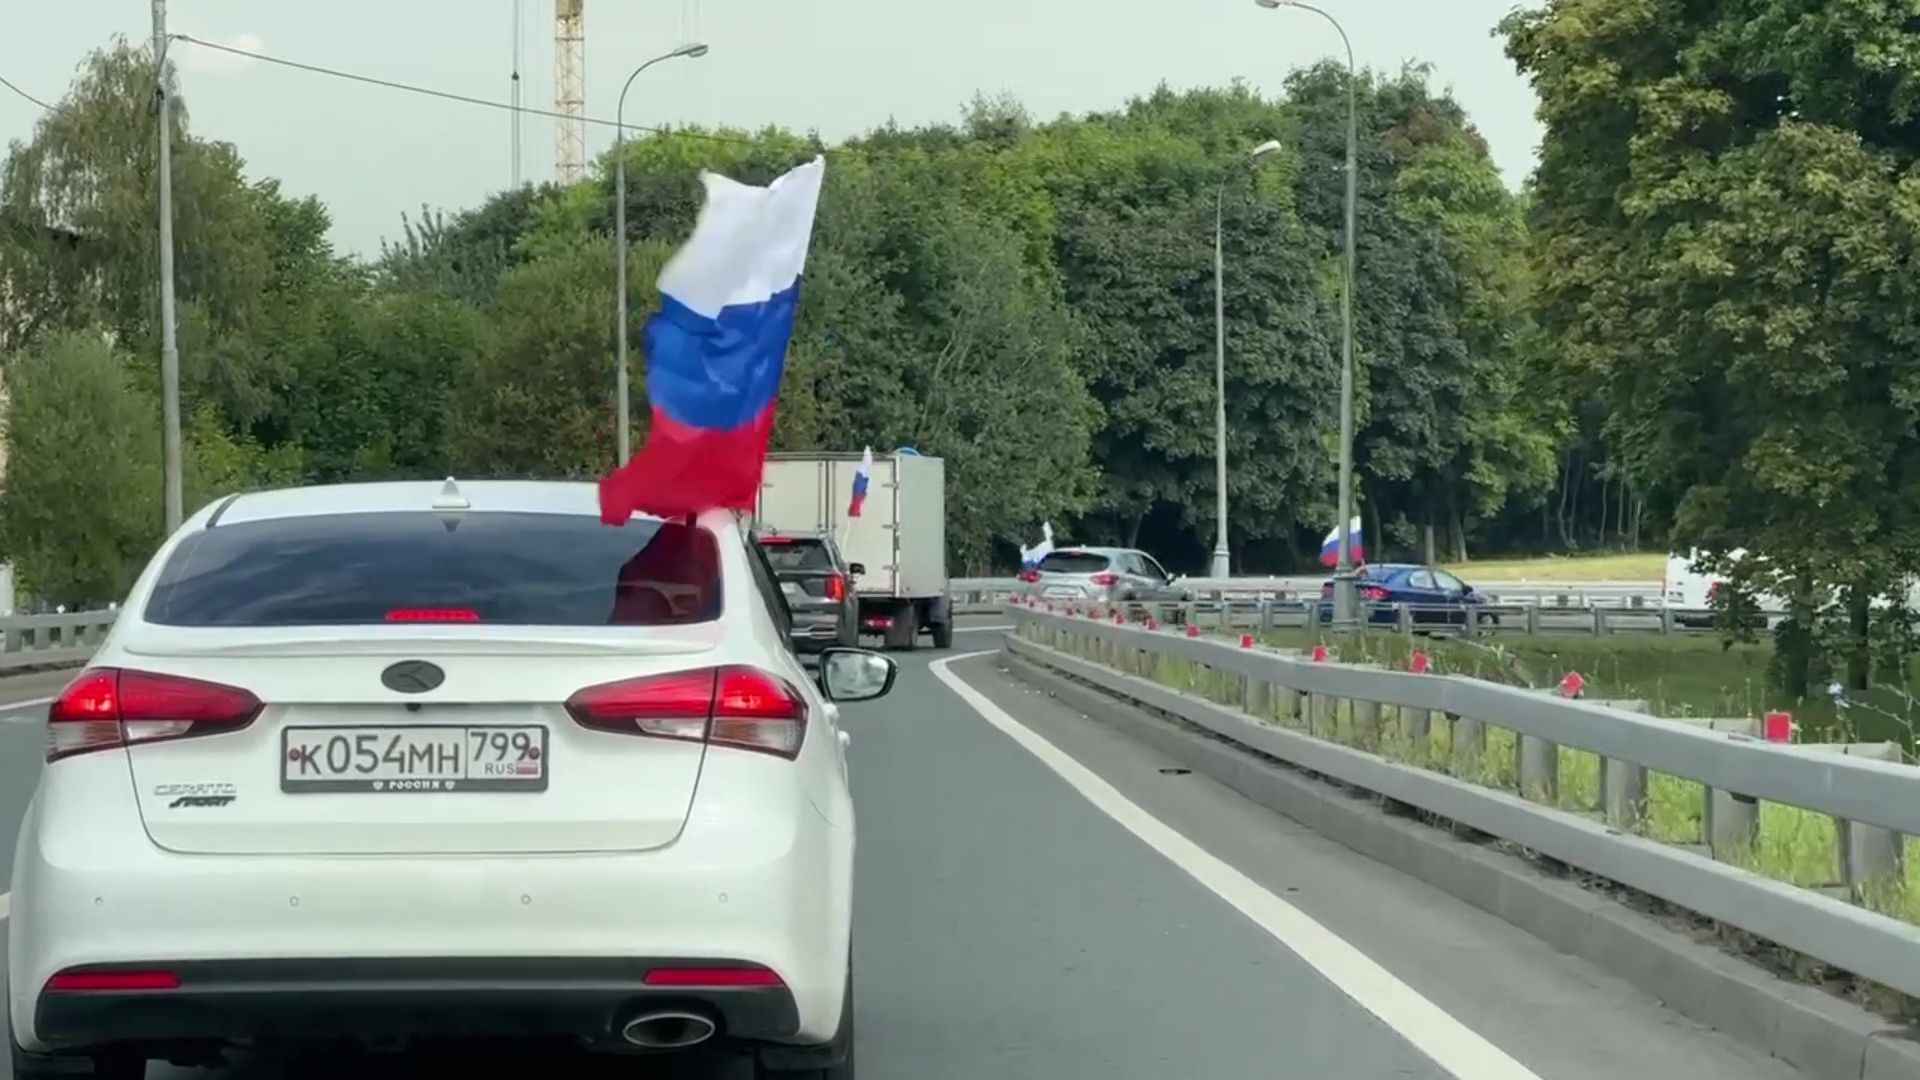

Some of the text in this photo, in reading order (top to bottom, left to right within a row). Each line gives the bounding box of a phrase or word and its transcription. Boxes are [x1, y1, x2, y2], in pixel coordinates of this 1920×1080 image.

[470, 731, 532, 762] 799
[485, 763, 515, 775] RUS
[389, 780, 440, 791] РОССИЯ
